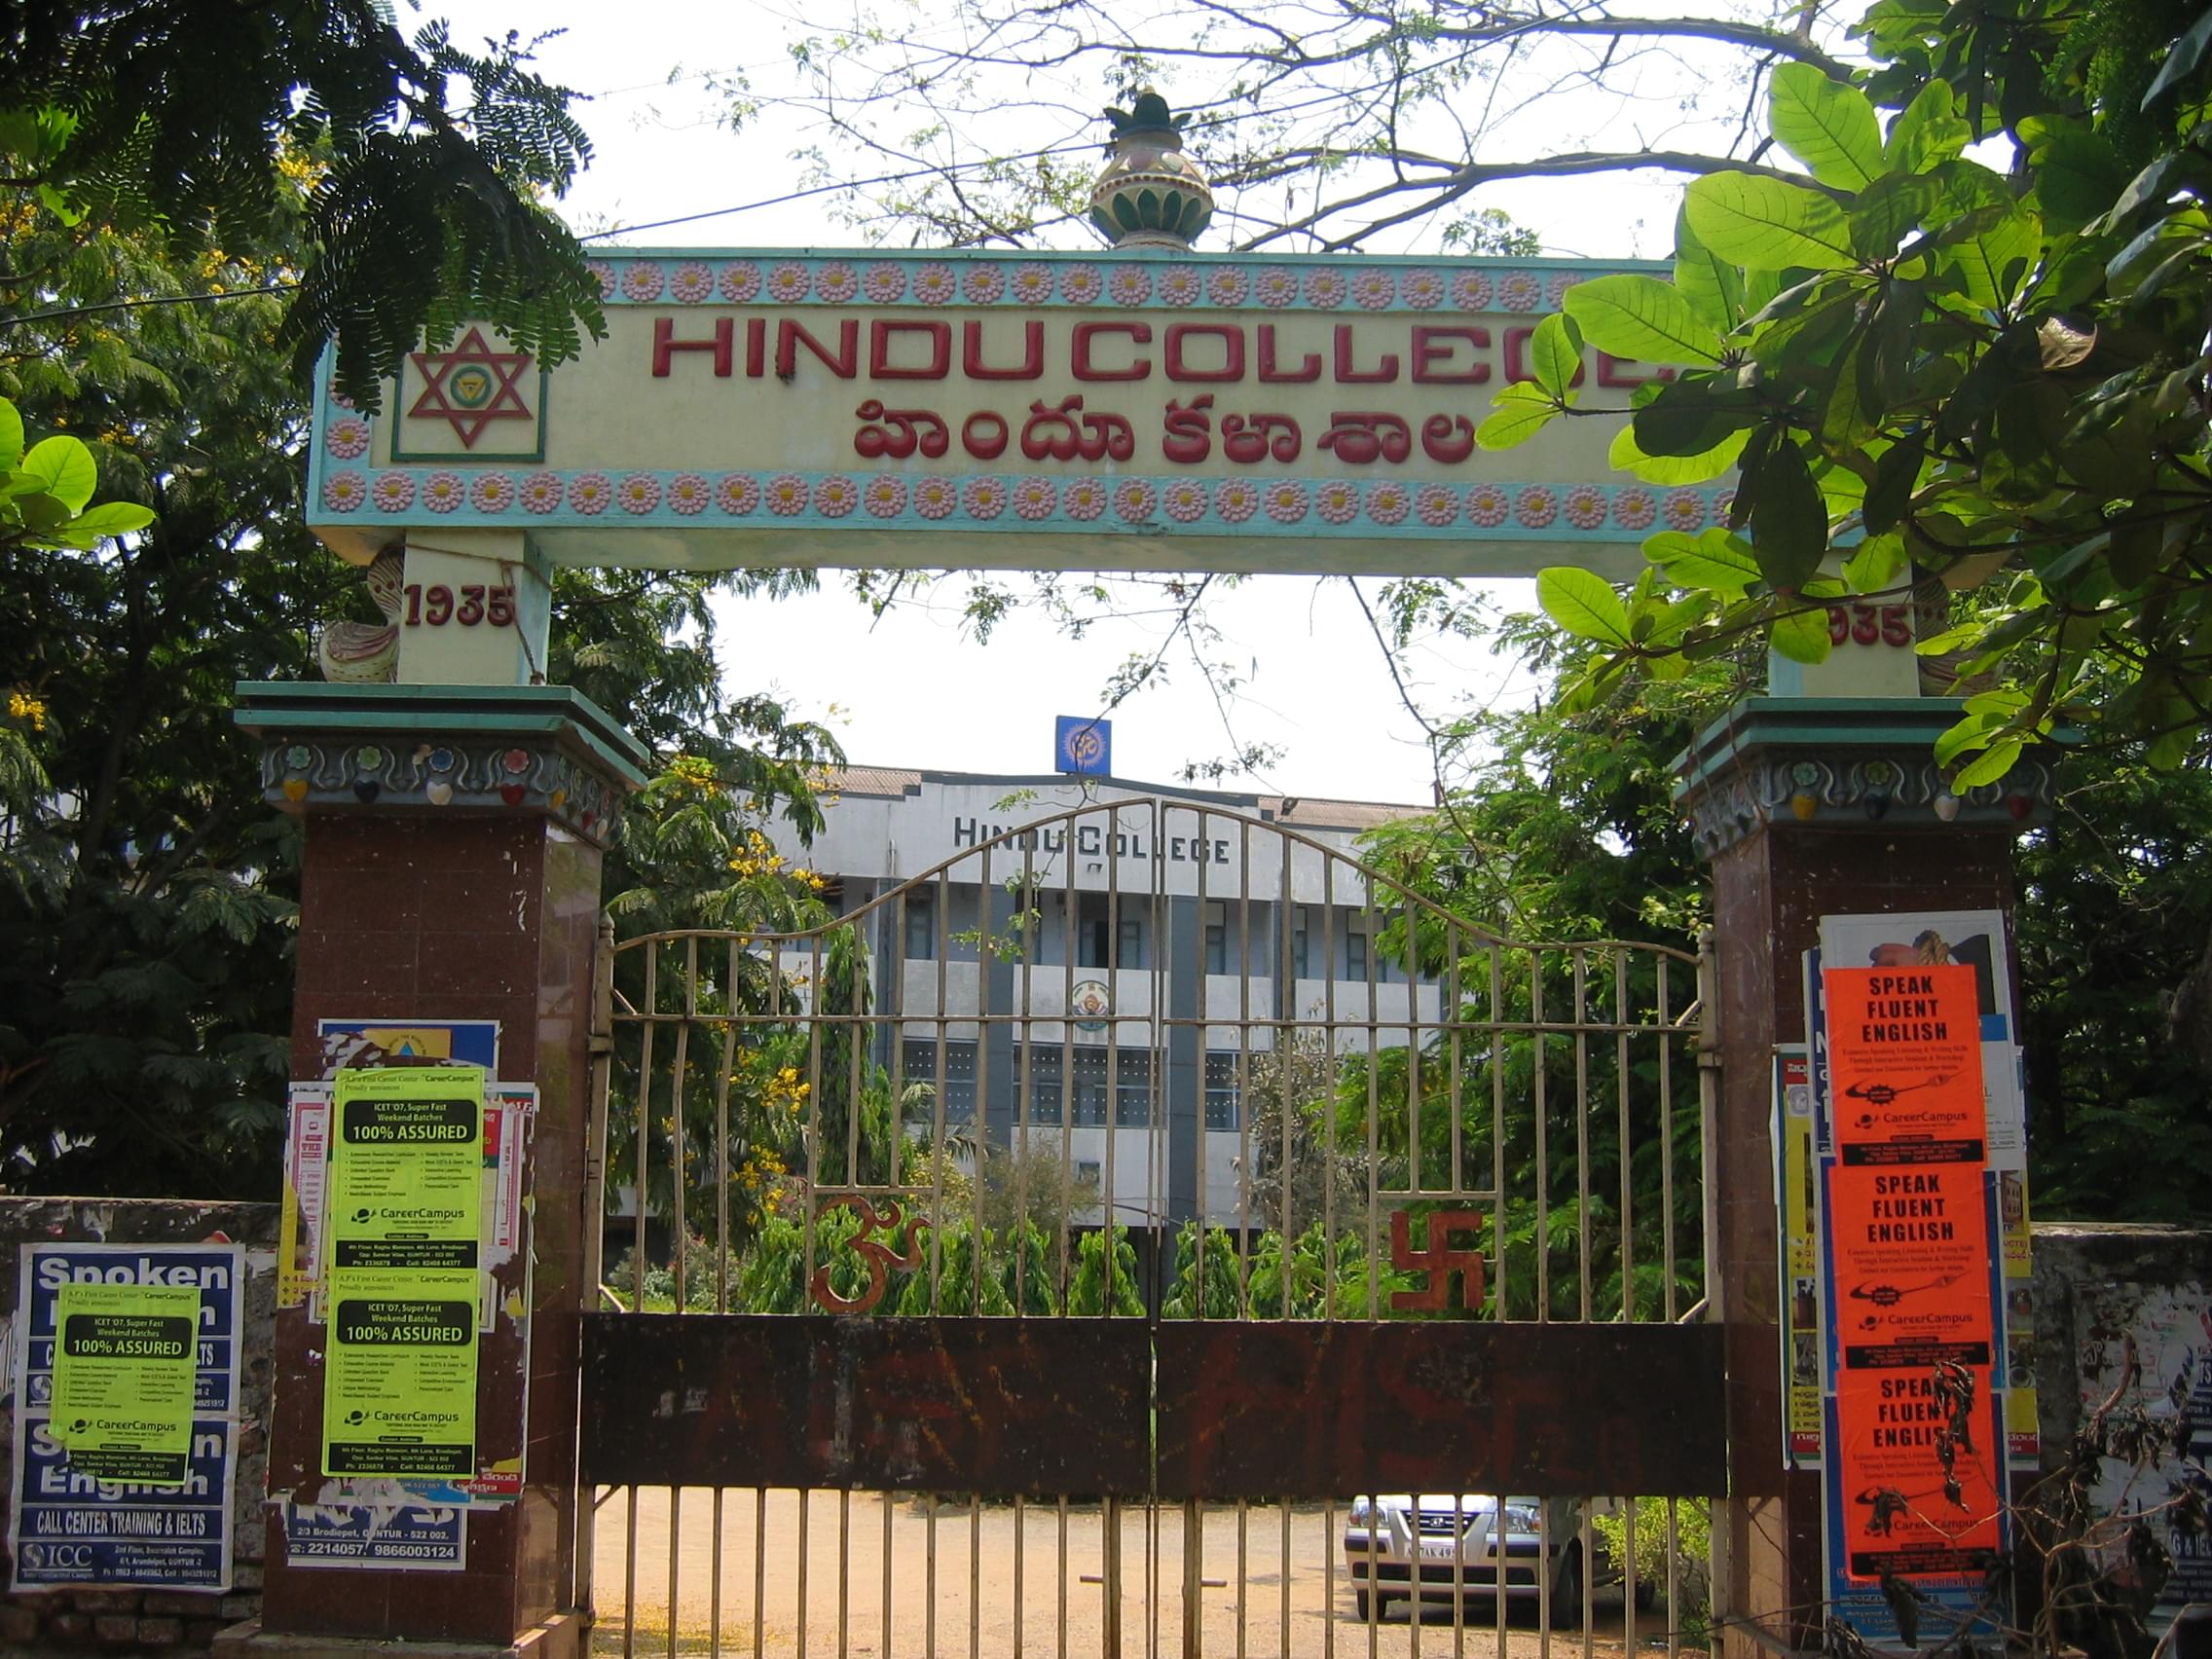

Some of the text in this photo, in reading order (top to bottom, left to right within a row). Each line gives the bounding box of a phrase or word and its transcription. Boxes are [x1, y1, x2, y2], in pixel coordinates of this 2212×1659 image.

[651, 317, 1045, 380] HINDU
[853, 392, 1135, 461] హిందూ
[403, 584, 514, 627] 1935
[1827, 606, 1911, 646] 935
[953, 816, 1065, 853] HINDU
[1868, 977, 1934, 996] SPEAK
[1867, 999, 1939, 1019] FLUENT
[1862, 1022, 1948, 1044] ENGLISH
[407, 1103, 429, 1113] Super
[1883, 1112, 1969, 1124] CareerCampus
[352, 1124, 468, 1140] 100% ASSURED
[1875, 1174, 1940, 1195] SPEAK
[381, 1207, 465, 1221] CareerCampus
[1872, 1198, 1945, 1218] FLUENT
[1867, 1222, 1954, 1243] ENGLISH
[368, 1304, 385, 1312] ICET
[402, 1305, 424, 1313] Super
[127, 1318, 148, 1329] Super
[149, 1318, 165, 1328] Fast
[371, 1314, 407, 1323] Weekend
[1888, 1312, 1973, 1325] CareerCampus
[347, 1326, 463, 1342] 100% ASSURED
[73, 1339, 183, 1355] 100% ASSURED
[1880, 1378, 1947, 1398] SPEA
[96, 1419, 177, 1433] CareerCampus
[374, 1410, 460, 1424] CareerCampus
[1873, 1426, 1957, 1448] ENGLIS
[40, 1464, 209, 1500] Engh
[37, 1510, 206, 1535] CALL CENTER TRAINING & IELTS
[362, 1530, 402, 1539] GNTUR
[410, 1530, 427, 1539] 522
[48, 1544, 93, 1568] ICC
[374, 1544, 456, 1559] 9866003124
